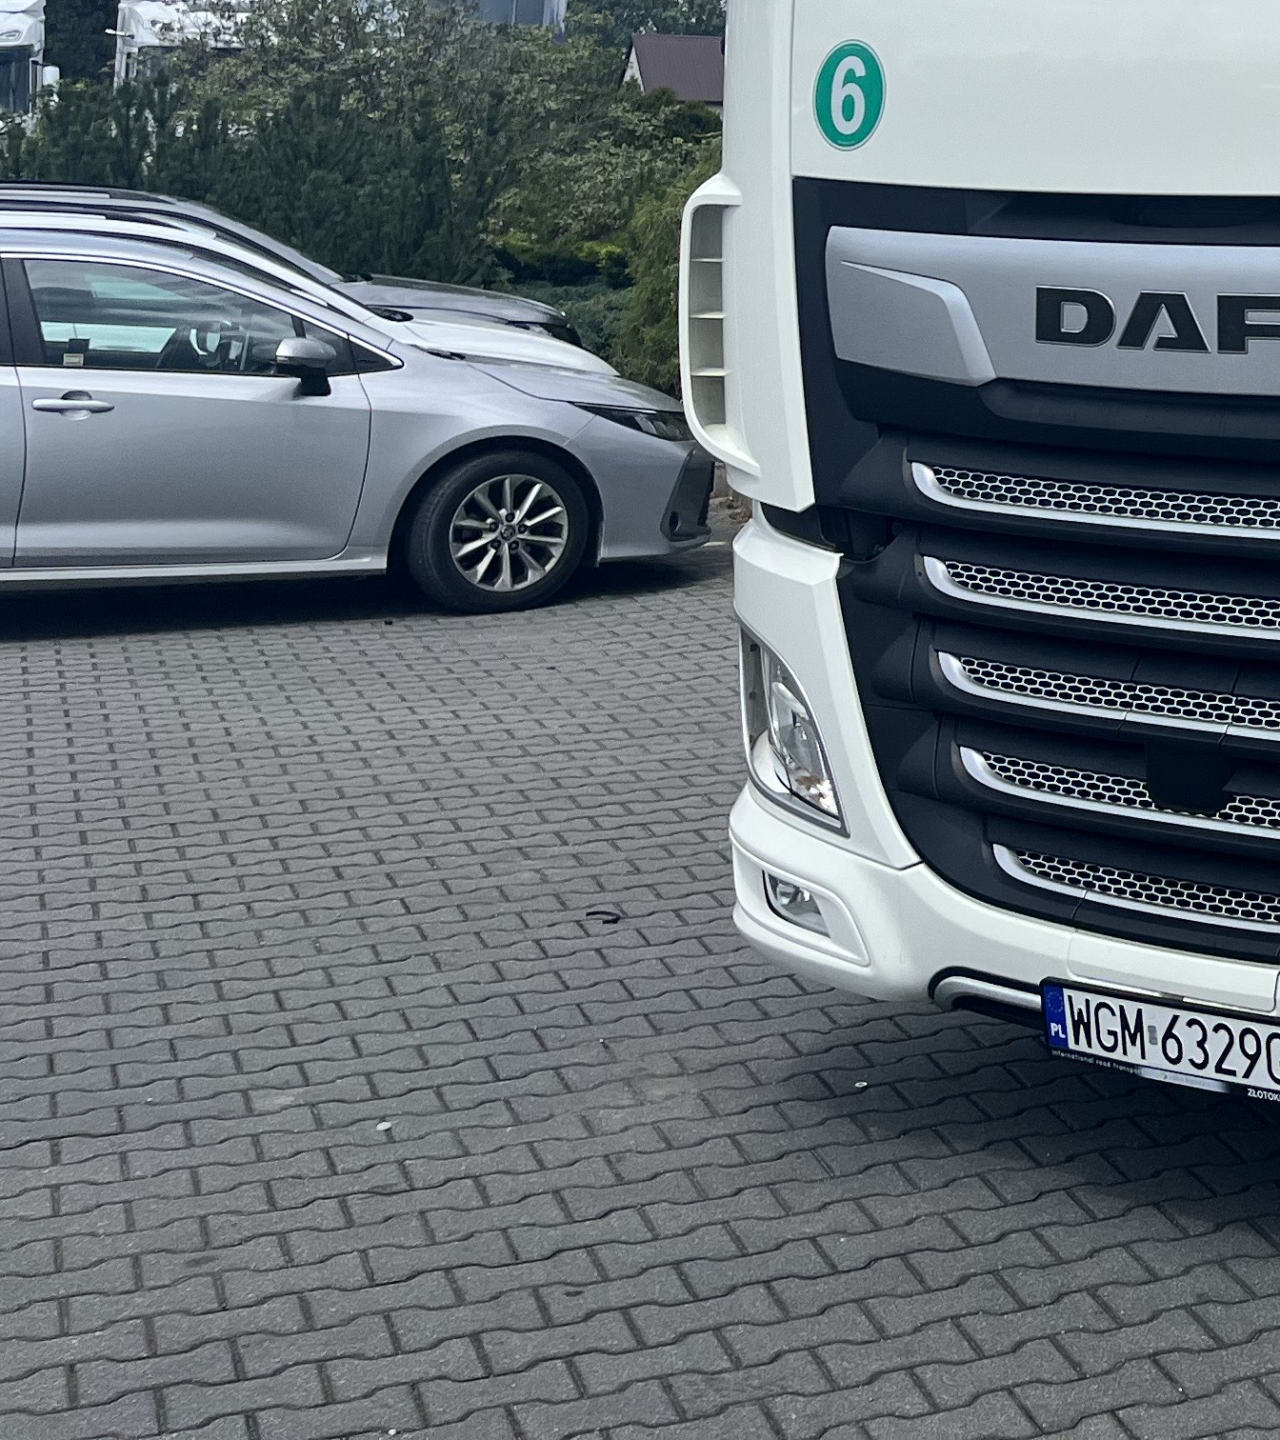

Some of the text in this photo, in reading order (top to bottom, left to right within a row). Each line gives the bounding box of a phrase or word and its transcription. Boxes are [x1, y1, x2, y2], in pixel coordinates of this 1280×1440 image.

[829, 55, 868, 136] 6
[1050, 1022, 1066, 1039] PL
[1067, 993, 1147, 1060] WGM
